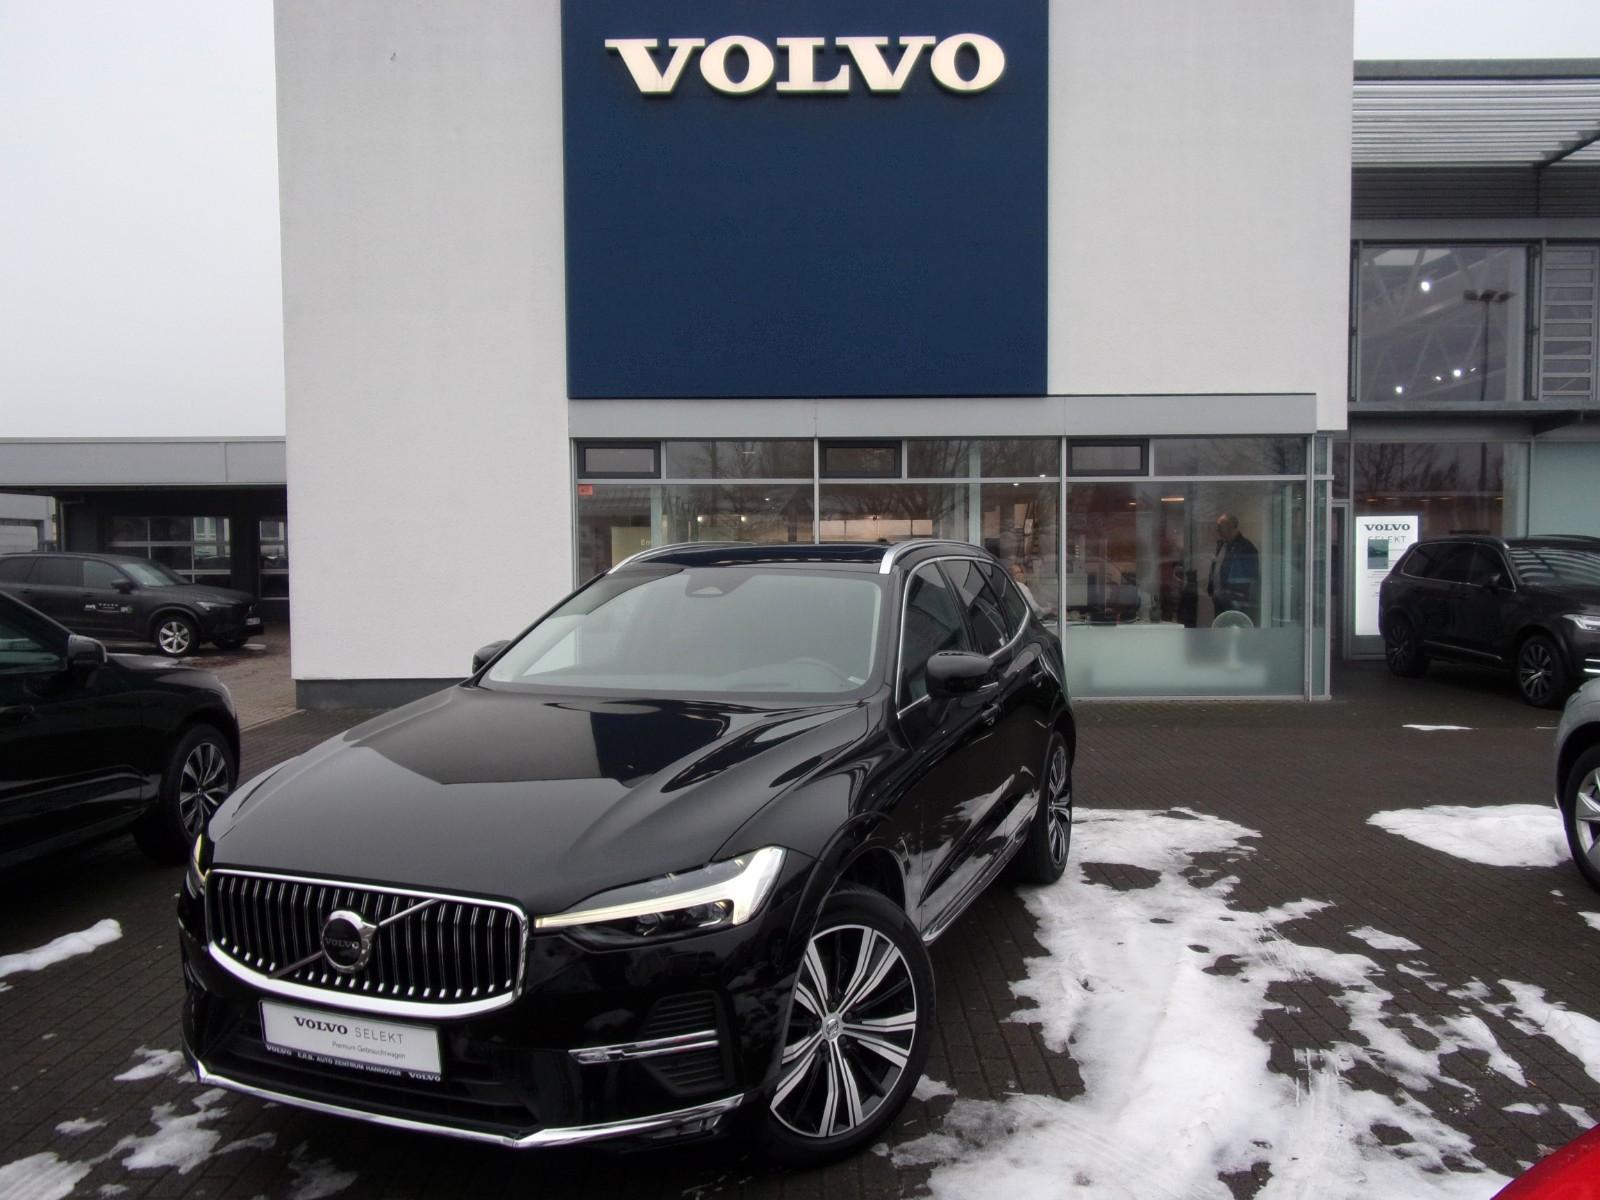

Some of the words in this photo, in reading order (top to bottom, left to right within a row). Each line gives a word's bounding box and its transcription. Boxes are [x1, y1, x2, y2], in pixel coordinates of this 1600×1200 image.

[604, 33, 1006, 94] VOLVO
[1364, 523, 1411, 532] VOLVO
[325, 937, 360, 950] VOLVO
[294, 1015, 349, 1036] VOLVO
[354, 1027, 404, 1045] SELEKT
[265, 1044, 293, 1057] VOLVO
[331, 1040, 356, 1052] Premium
[316, 1055, 333, 1065] AUTO
[334, 1058, 364, 1071] ZENTRUM
[365, 1064, 402, 1077] HANNOVER
[408, 1071, 442, 1083] VOLVO
